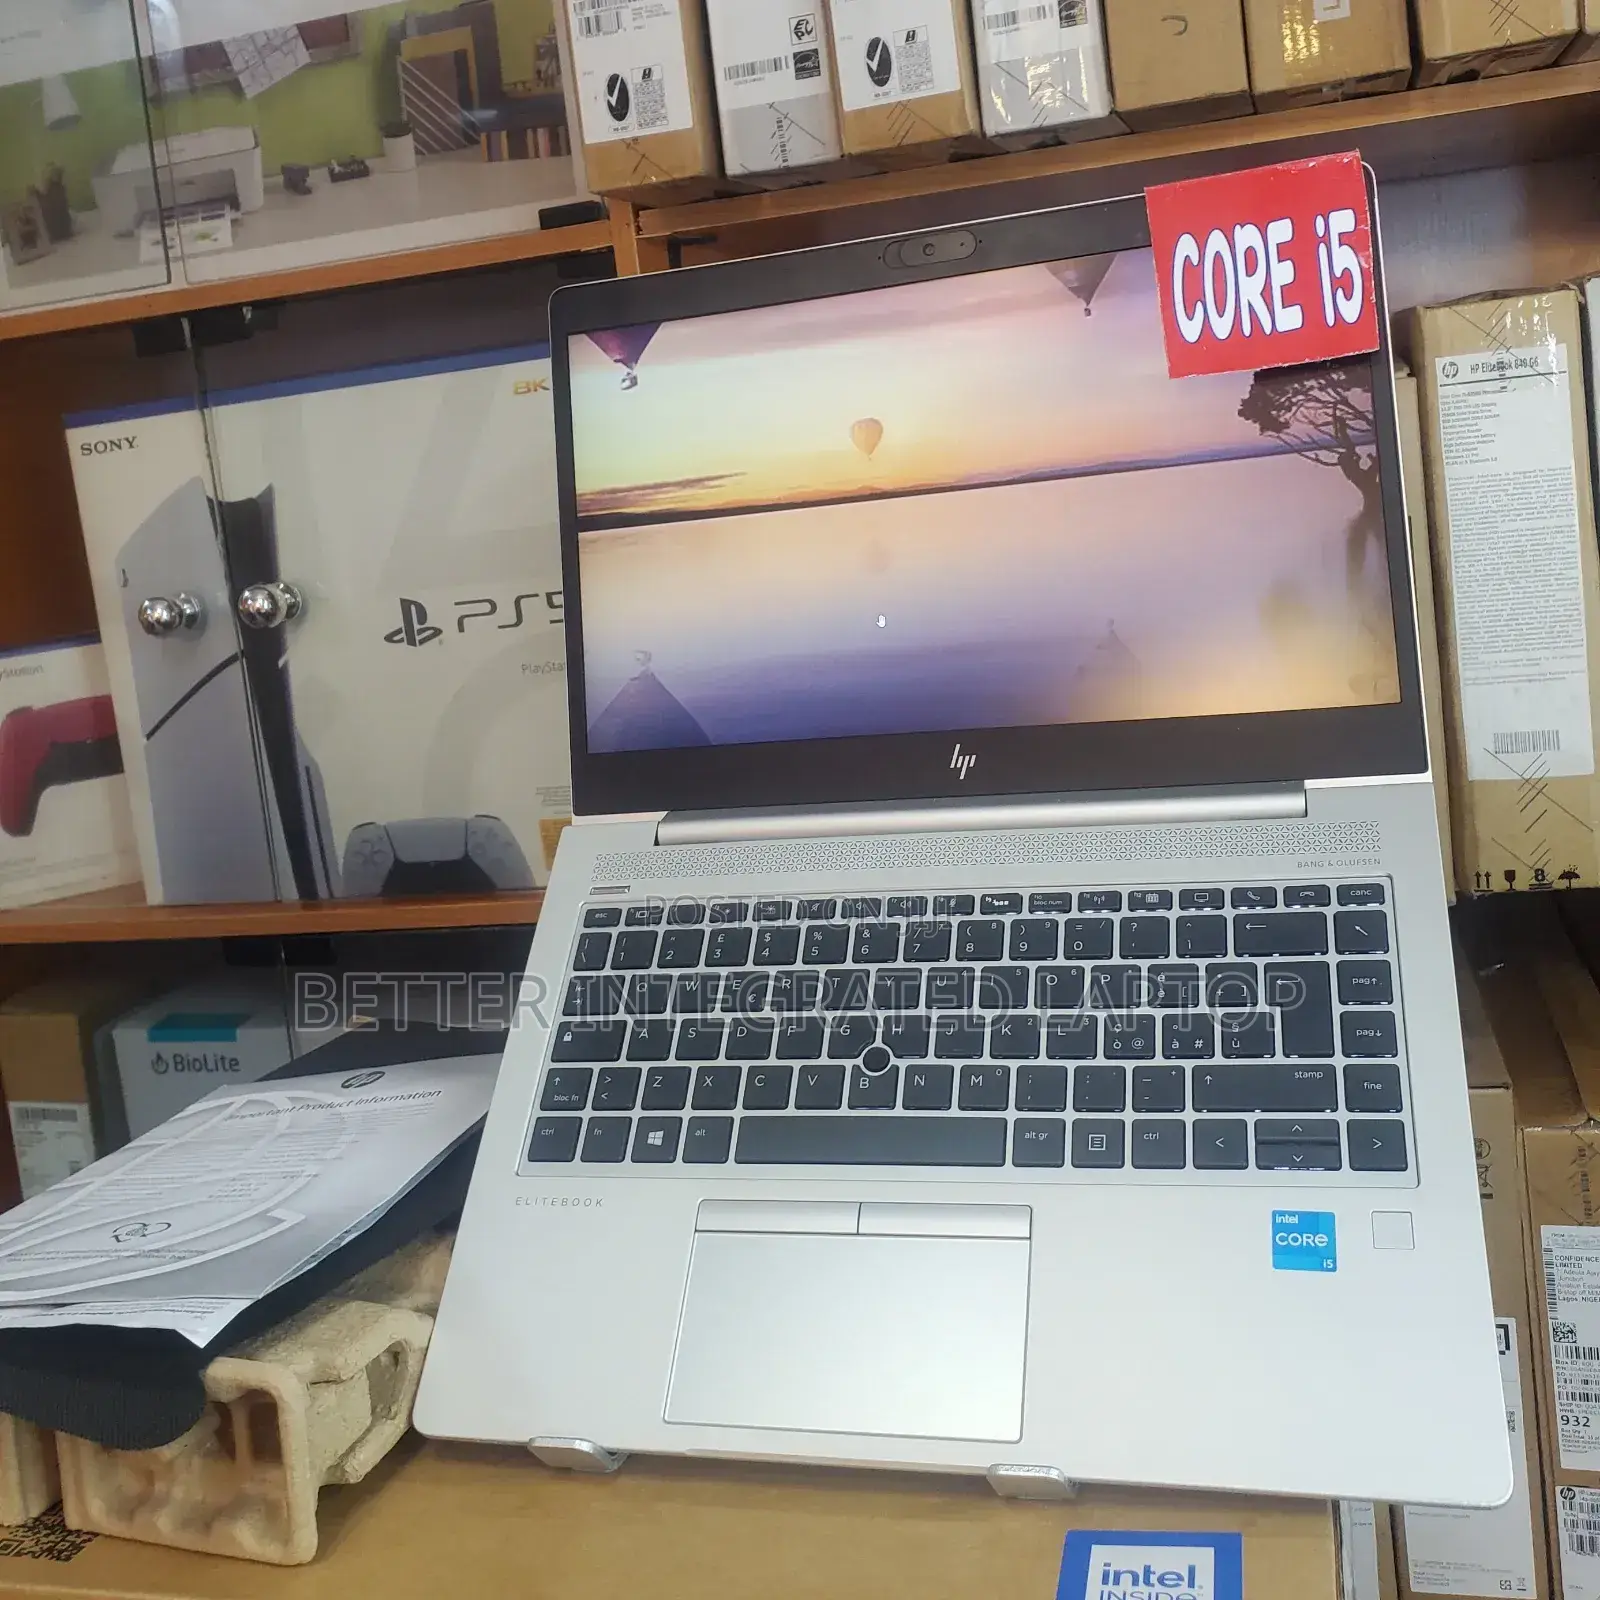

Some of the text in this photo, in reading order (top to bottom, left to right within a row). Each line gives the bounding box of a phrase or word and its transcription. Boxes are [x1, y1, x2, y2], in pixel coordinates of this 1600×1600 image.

[1172, 208, 1364, 344] CORE i5
[1470, 363, 1480, 374] HP
[513, 378, 550, 395] 8K
[80, 436, 138, 456] SONY
[950, 743, 977, 780] hp
[1297, 858, 1381, 869] BANG & OLUFSEN
[1350, 889, 1372, 897] canc
[717, 934, 725, 943] £
[764, 932, 772, 943] $
[813, 932, 823, 941] %
[862, 928, 871, 939] &
[1045, 921, 1051, 929] 9
[1130, 922, 1138, 932] ?
[665, 951, 674, 960] 2
[713, 948, 722, 959] 3
[761, 948, 770, 958] 4
[811, 946, 819, 956] 5
[861, 944, 869, 954] 6
[912, 944, 921, 953] 7
[966, 942, 974, 952] 8
[1019, 941, 1028, 952] 9
[1016, 968, 1022, 976] 5
[1071, 968, 1077, 976] 6
[636, 982, 648, 993] Q
[686, 981, 700, 992] W
[732, 980, 741, 990] E
[781, 979, 792, 989] R
[832, 978, 841, 988] T
[884, 976, 895, 987] Y
[937, 976, 947, 987] U
[1046, 974, 1058, 986] O
[1101, 974, 1111, 985] P
[748, 993, 756, 1003] €
[1027, 1018, 1034, 1026] 2
[1083, 1018, 1090, 1026] 3
[638, 1028, 649, 1039] A
[687, 1028, 697, 1039] S
[736, 1026, 747, 1037] D
[787, 1026, 796, 1037] F
[840, 1025, 851, 1036] G
[892, 1025, 902, 1035] H
[945, 1025, 954, 1036] J
[1001, 1025, 1012, 1036] K
[1057, 1025, 1067, 1036] L
[1113, 1037, 1240, 1050] ò @ à # ù
[172, 1052, 241, 1073] BioLite
[1294, 1070, 1324, 1080] stamp
[652, 1076, 663, 1087] Z
[702, 1076, 714, 1087] X
[754, 1075, 765, 1086] C
[807, 1075, 819, 1086] V
[859, 1077, 869, 1089] B
[914, 1075, 925, 1086] N
[970, 1075, 983, 1086] M
[1363, 1081, 1382, 1090] fine
[298, 1100, 353, 1113] Product
[355, 1090, 442, 1106] Information
[553, 1093, 569, 1102] bloc
[570, 1093, 579, 1102] fn
[541, 1127, 1160, 1141] ctrl fn alt alt gr ctrl
[515, 1196, 605, 1208] ELITEBOOK
[1275, 1214, 1299, 1224] intel
[1323, 1258, 1334, 1269] i5
[1555, 1254, 1600, 1263] CONFIDENCE
[1560, 1414, 1591, 1428] 932
[1560, 1486, 1576, 1500] hp
[1101, 1562, 1197, 1589] intel
